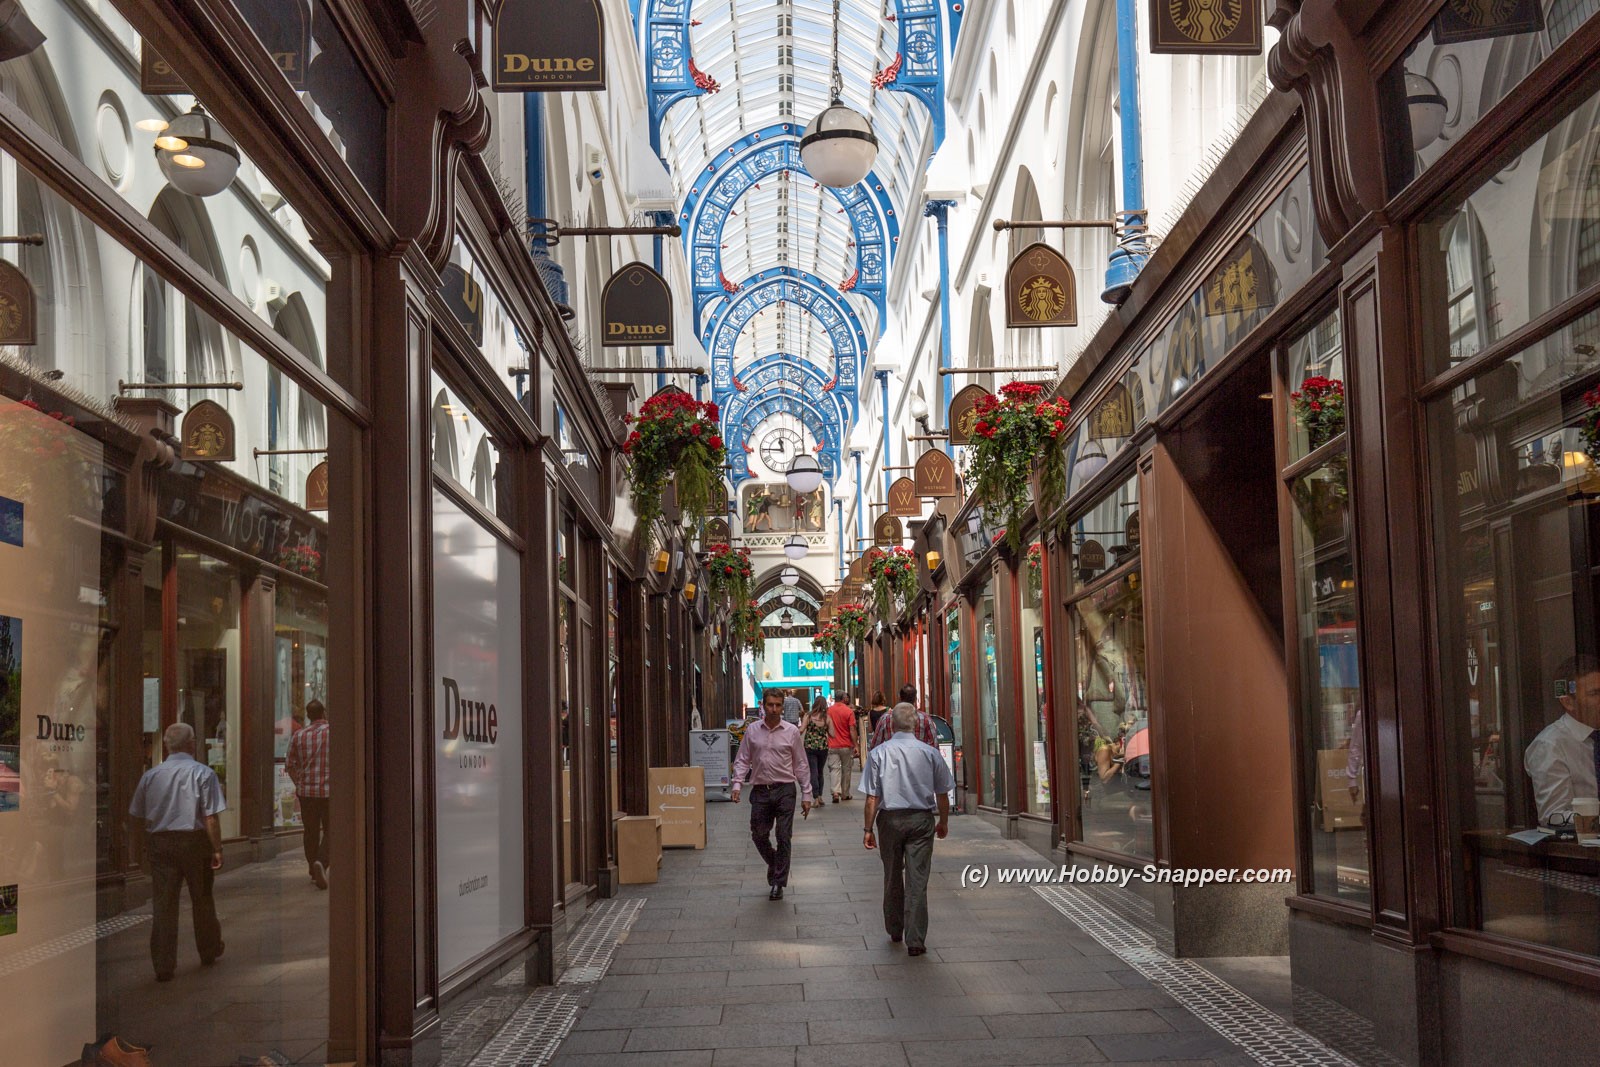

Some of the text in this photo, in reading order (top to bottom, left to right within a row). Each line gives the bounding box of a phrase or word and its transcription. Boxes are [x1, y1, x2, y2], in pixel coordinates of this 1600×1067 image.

[503, 53, 595, 73] Dune
[608, 322, 667, 335] Dune
[924, 466, 945, 483] W
[896, 492, 913, 506] W
[442, 676, 498, 745] Dune
[36, 714, 85, 741] Dune
[459, 753, 487, 769] LONDON
[657, 784, 696, 797] Village
